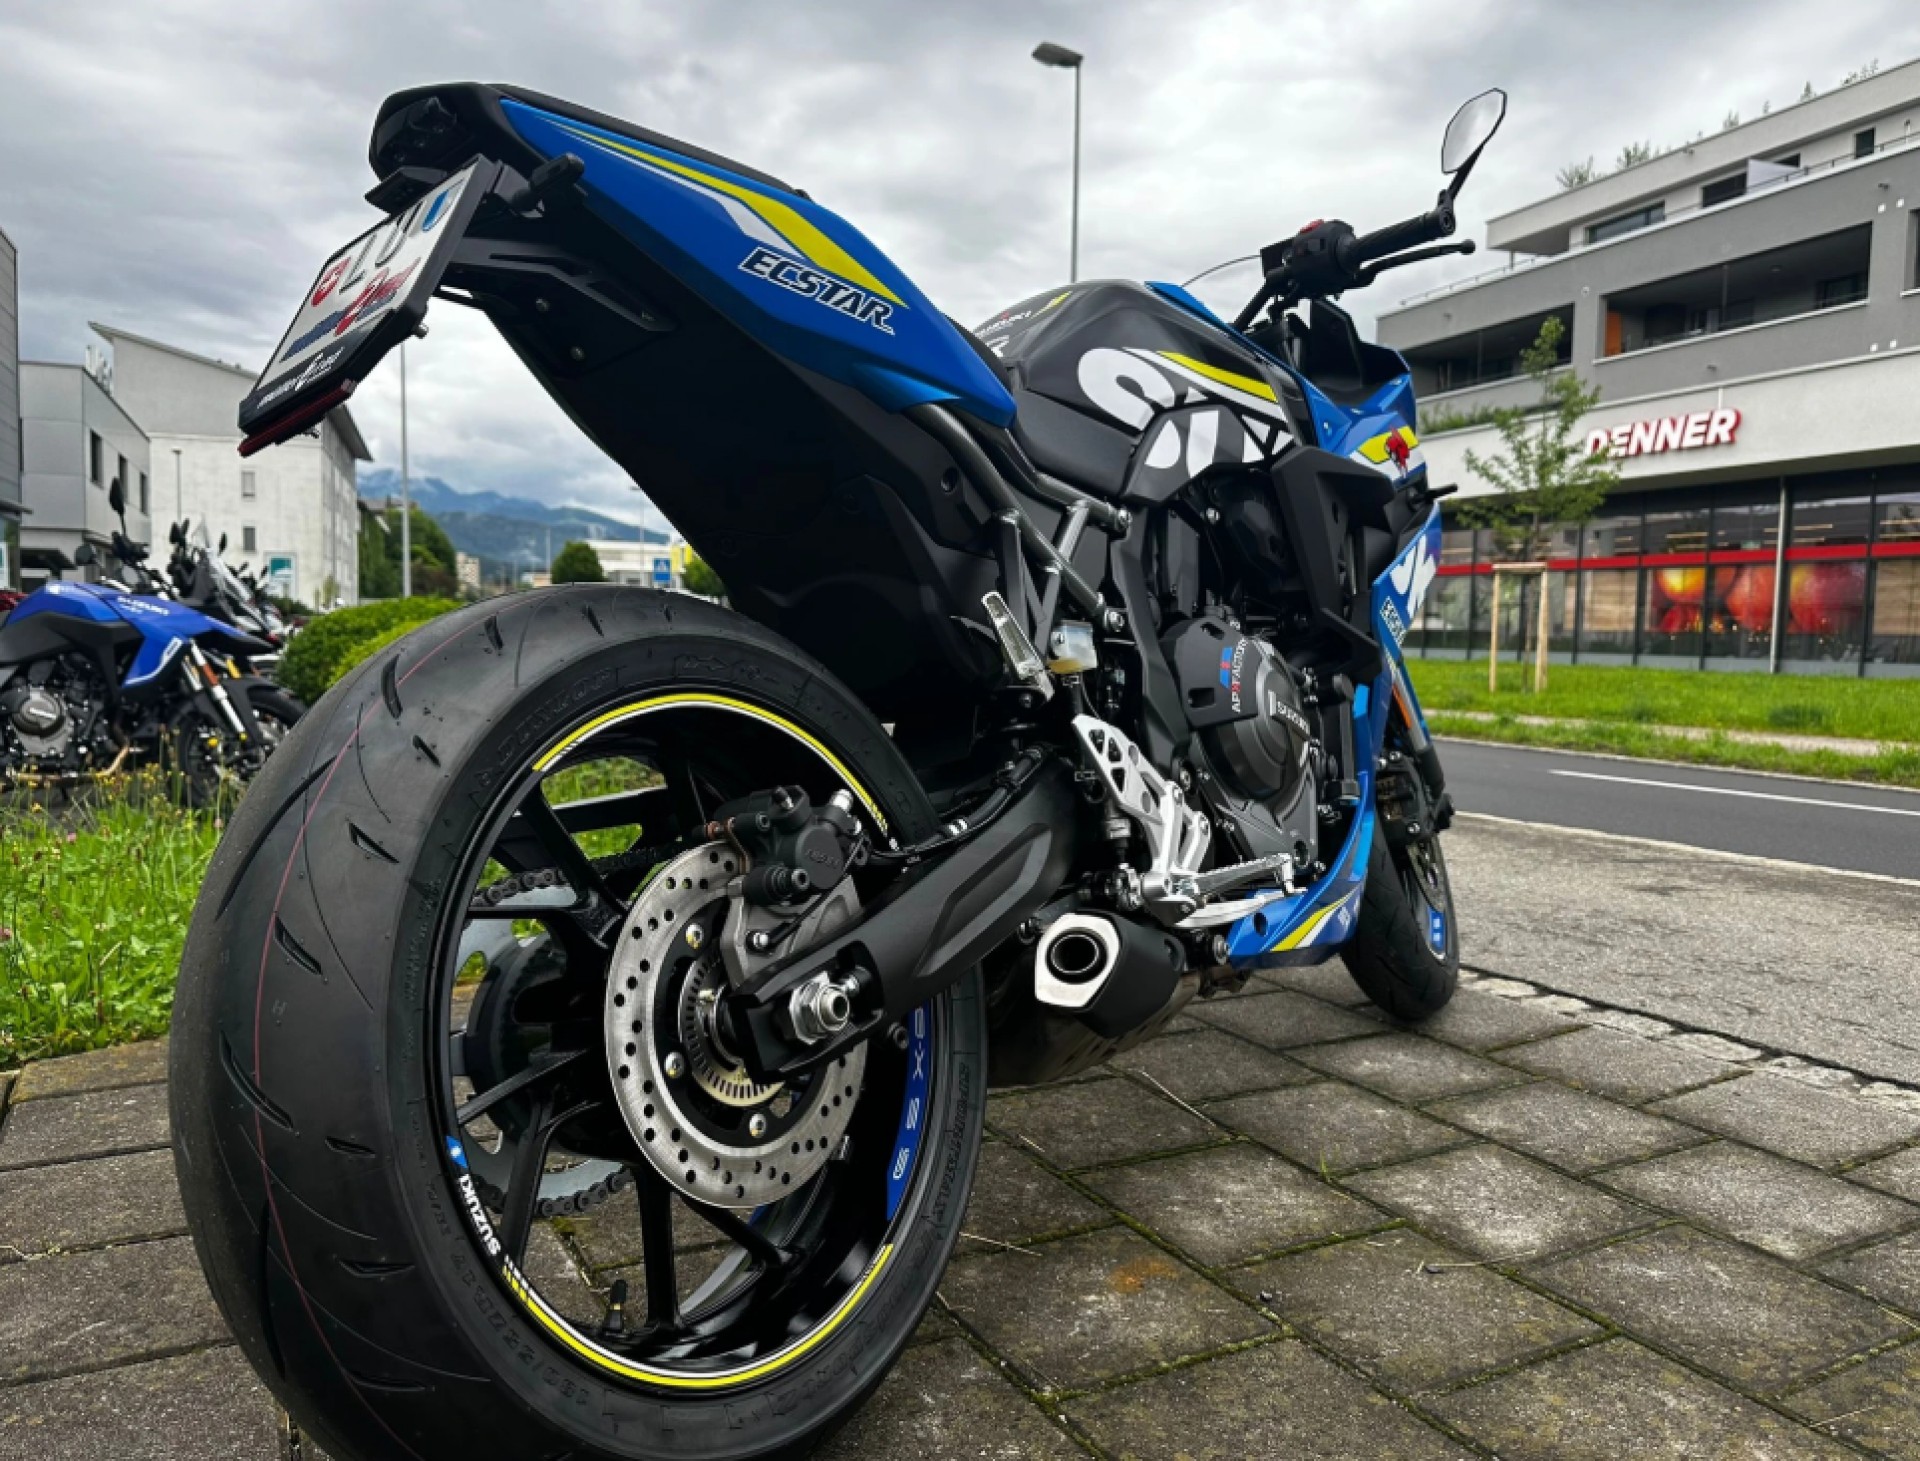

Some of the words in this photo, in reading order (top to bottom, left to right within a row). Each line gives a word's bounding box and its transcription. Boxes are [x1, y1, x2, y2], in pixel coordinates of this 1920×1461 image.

[737, 246, 896, 336] ECSTAR
[1584, 407, 1742, 458] DENNER
[457, 1173, 502, 1257] SUZUKI
